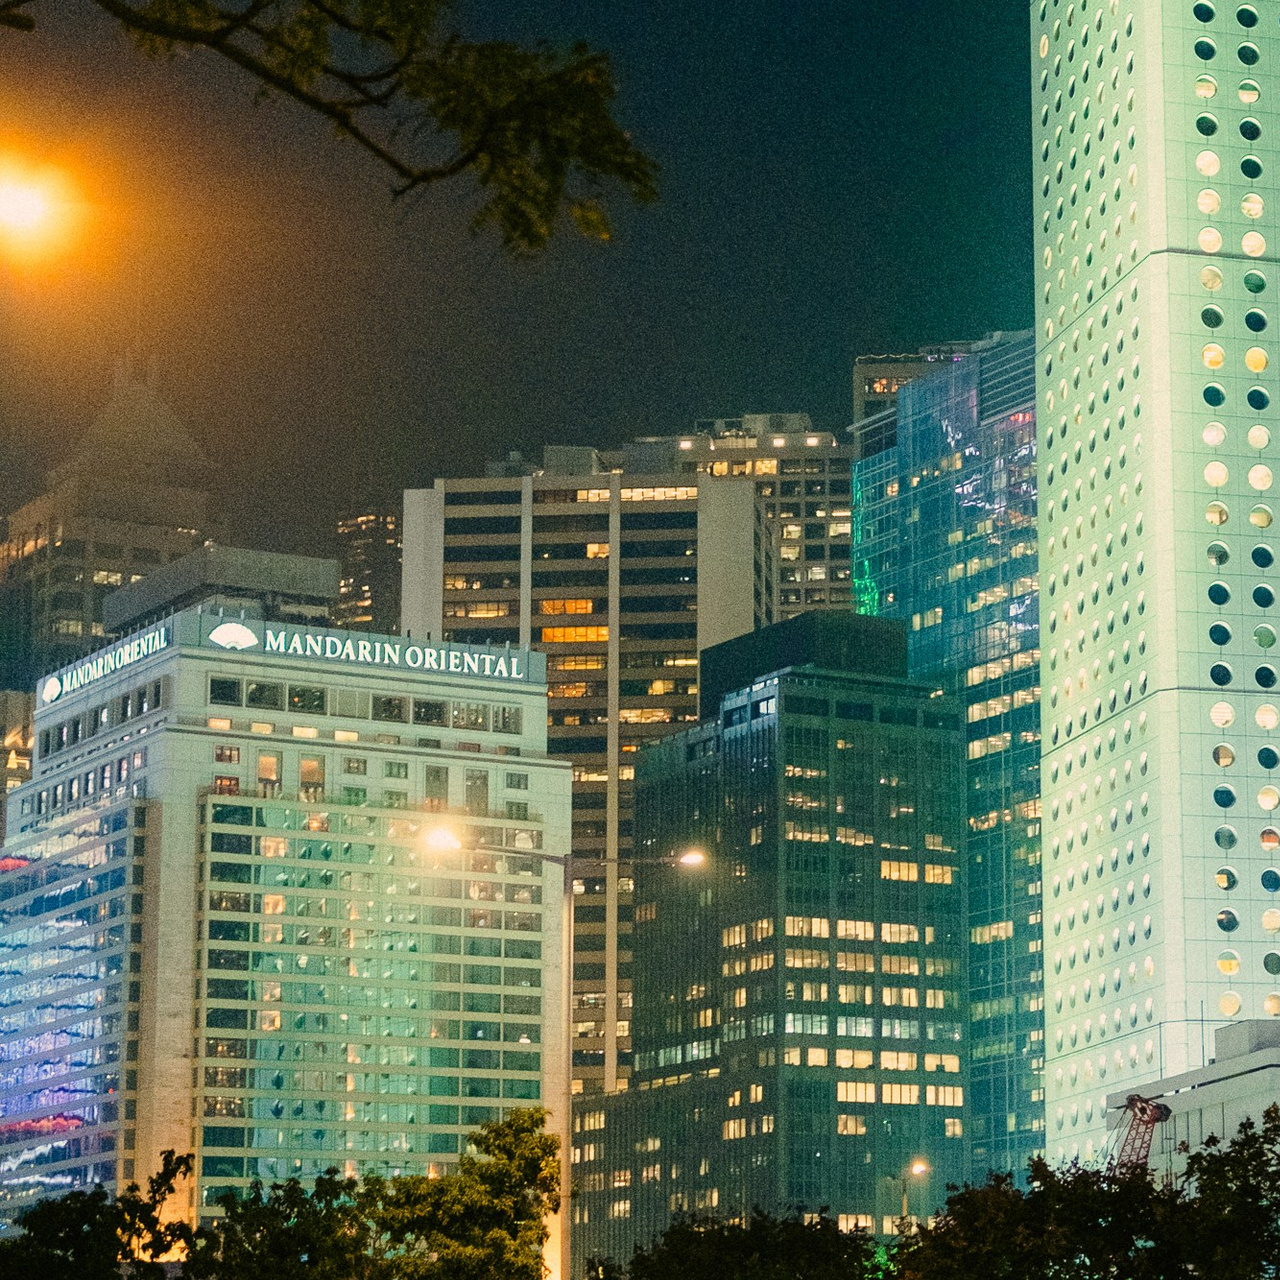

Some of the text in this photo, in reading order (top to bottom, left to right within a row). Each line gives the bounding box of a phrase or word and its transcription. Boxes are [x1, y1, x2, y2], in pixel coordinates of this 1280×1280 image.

[62, 627, 167, 694] MANDARIN ORIENTAL
[264, 629, 523, 679] MANDARIN ORIENTAL
